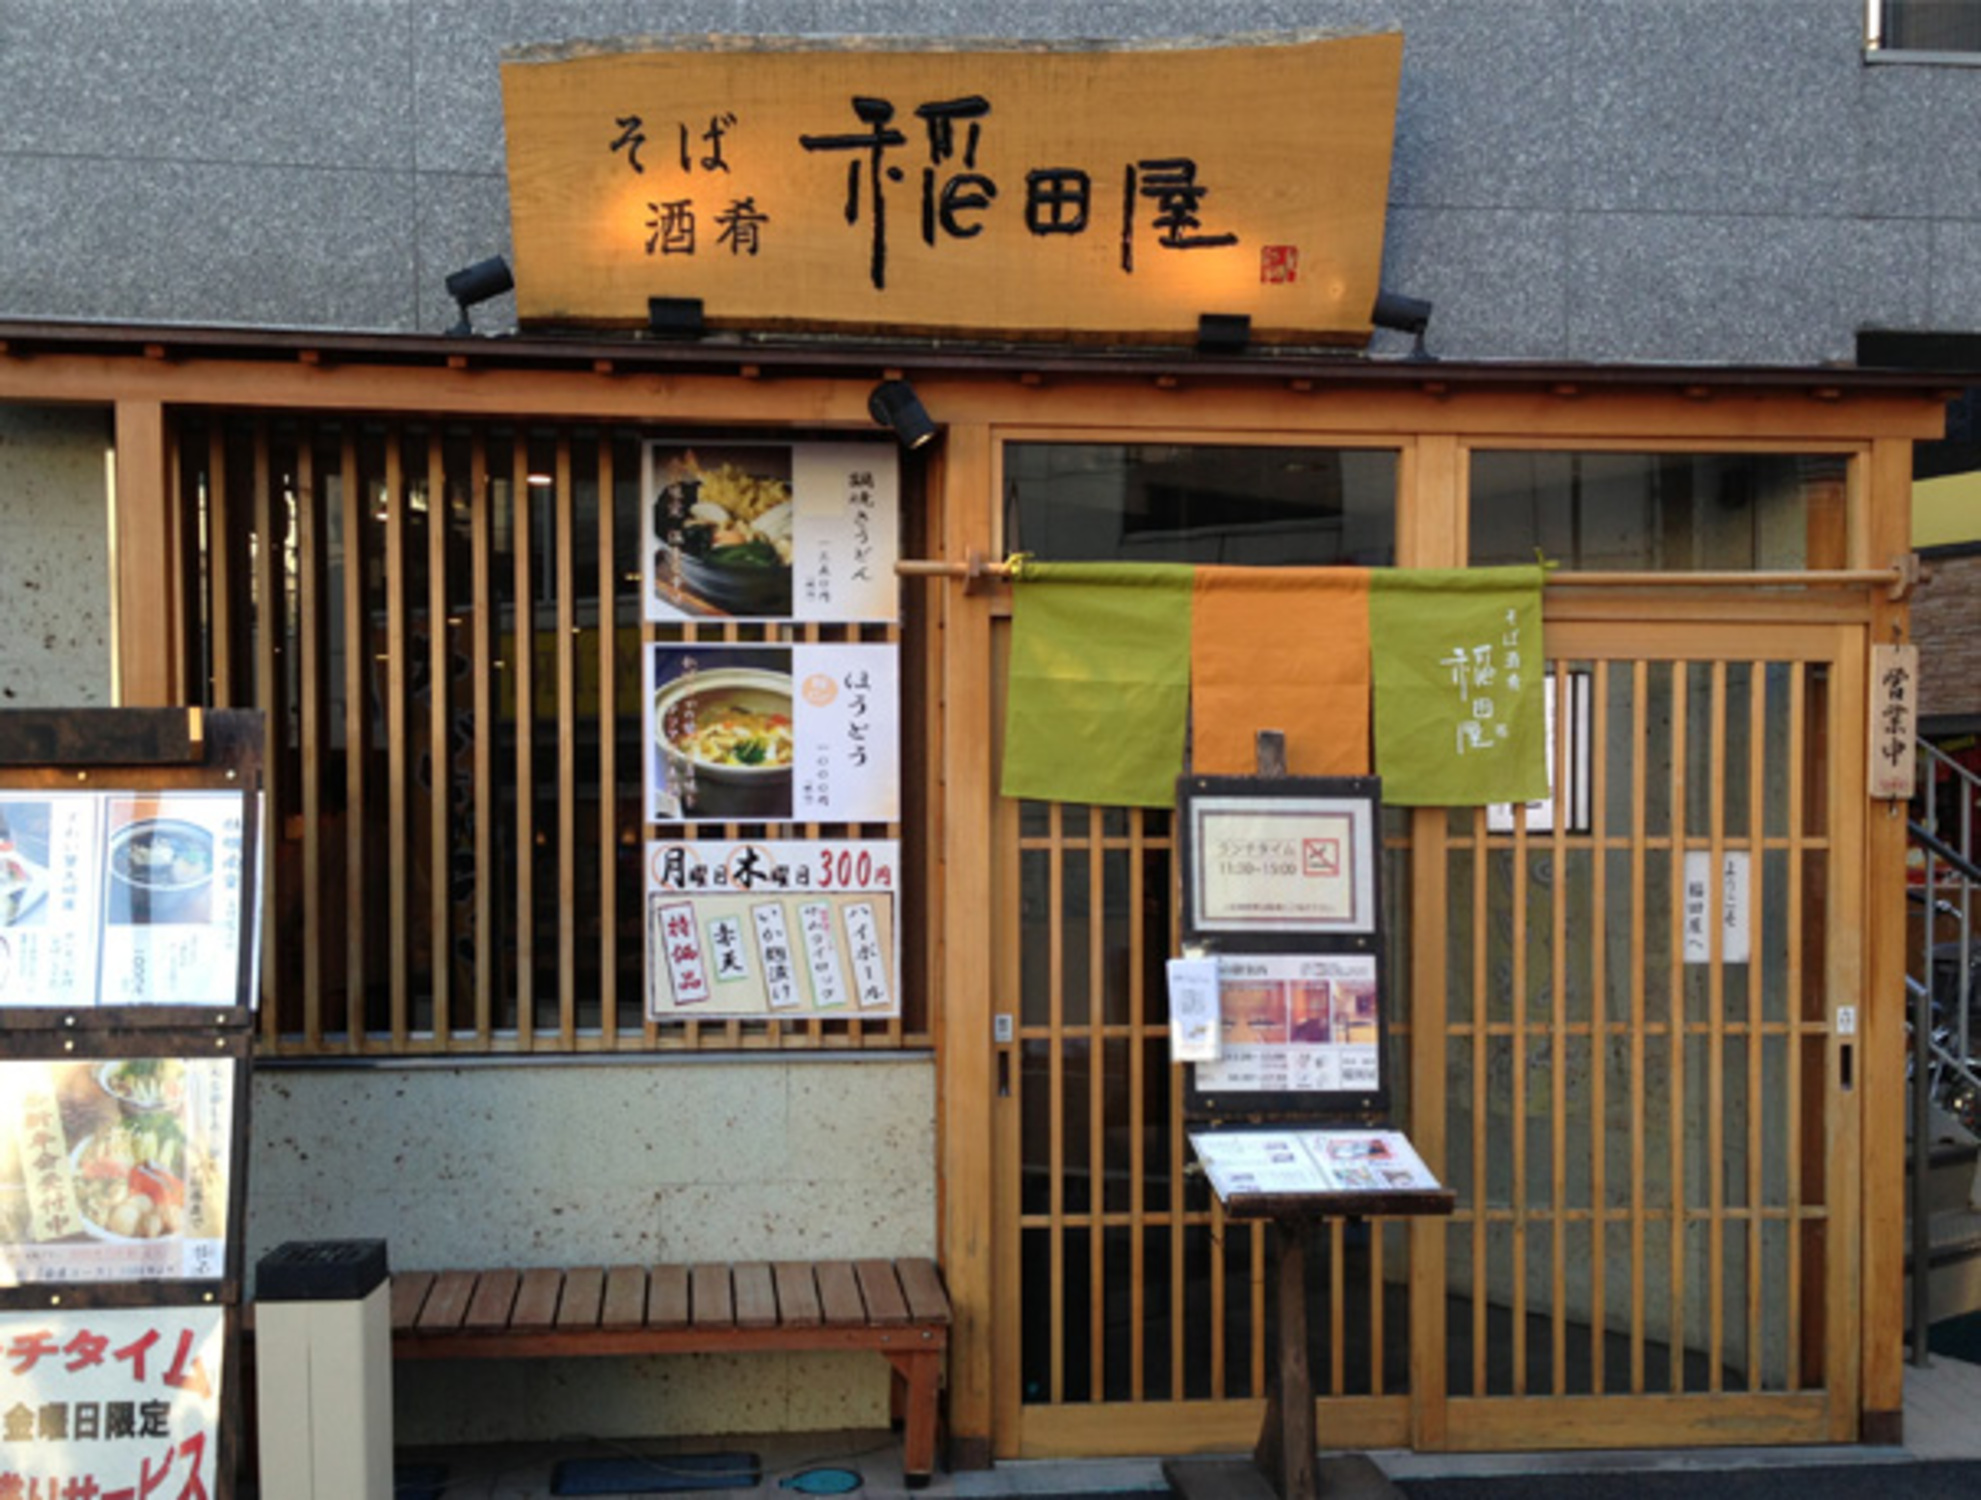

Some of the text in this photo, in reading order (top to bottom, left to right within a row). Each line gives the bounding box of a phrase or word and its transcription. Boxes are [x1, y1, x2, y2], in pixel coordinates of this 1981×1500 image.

[610, 111, 738, 173] そば
[799, 95, 1238, 289] 稲田屋
[645, 197, 770, 257] 酒肴
[1881, 667, 1910, 768] 営業中
[0, 1328, 212, 1399] チタイム
[3, 1398, 171, 1441] 金曜日限定
